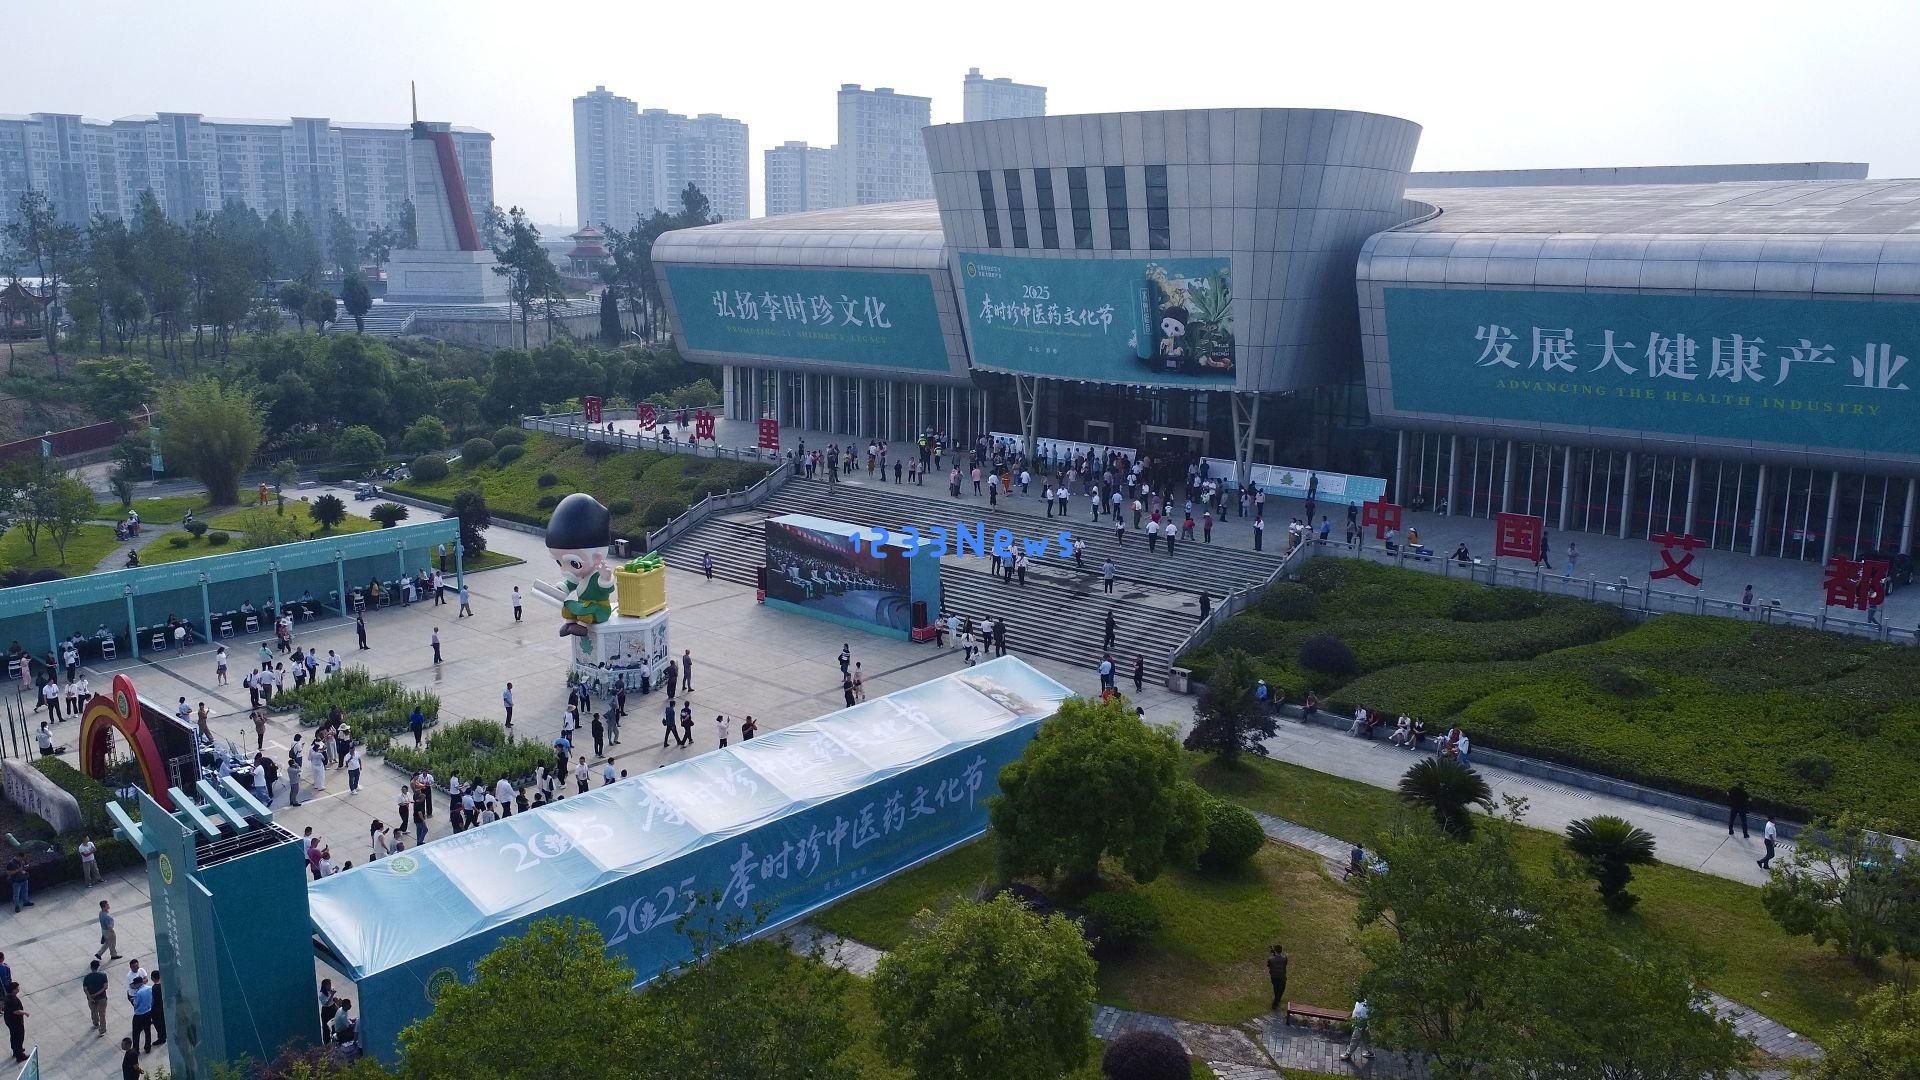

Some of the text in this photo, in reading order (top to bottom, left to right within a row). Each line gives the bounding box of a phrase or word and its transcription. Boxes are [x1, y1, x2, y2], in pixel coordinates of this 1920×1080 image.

[712, 290, 892, 328] 弘扬李时珍文化
[979, 292, 1115, 335] 李时珍中医药文化节
[1022, 284, 1050, 300] 2025
[1473, 323, 1910, 390] 发展大健康产业
[1496, 378, 1881, 416] ADVANCING THE HEALTH INDUSTRY
[499, 815, 614, 873] 2025
[716, 754, 987, 911] 李时珍中医药文化节
[606, 874, 698, 947] 2025
